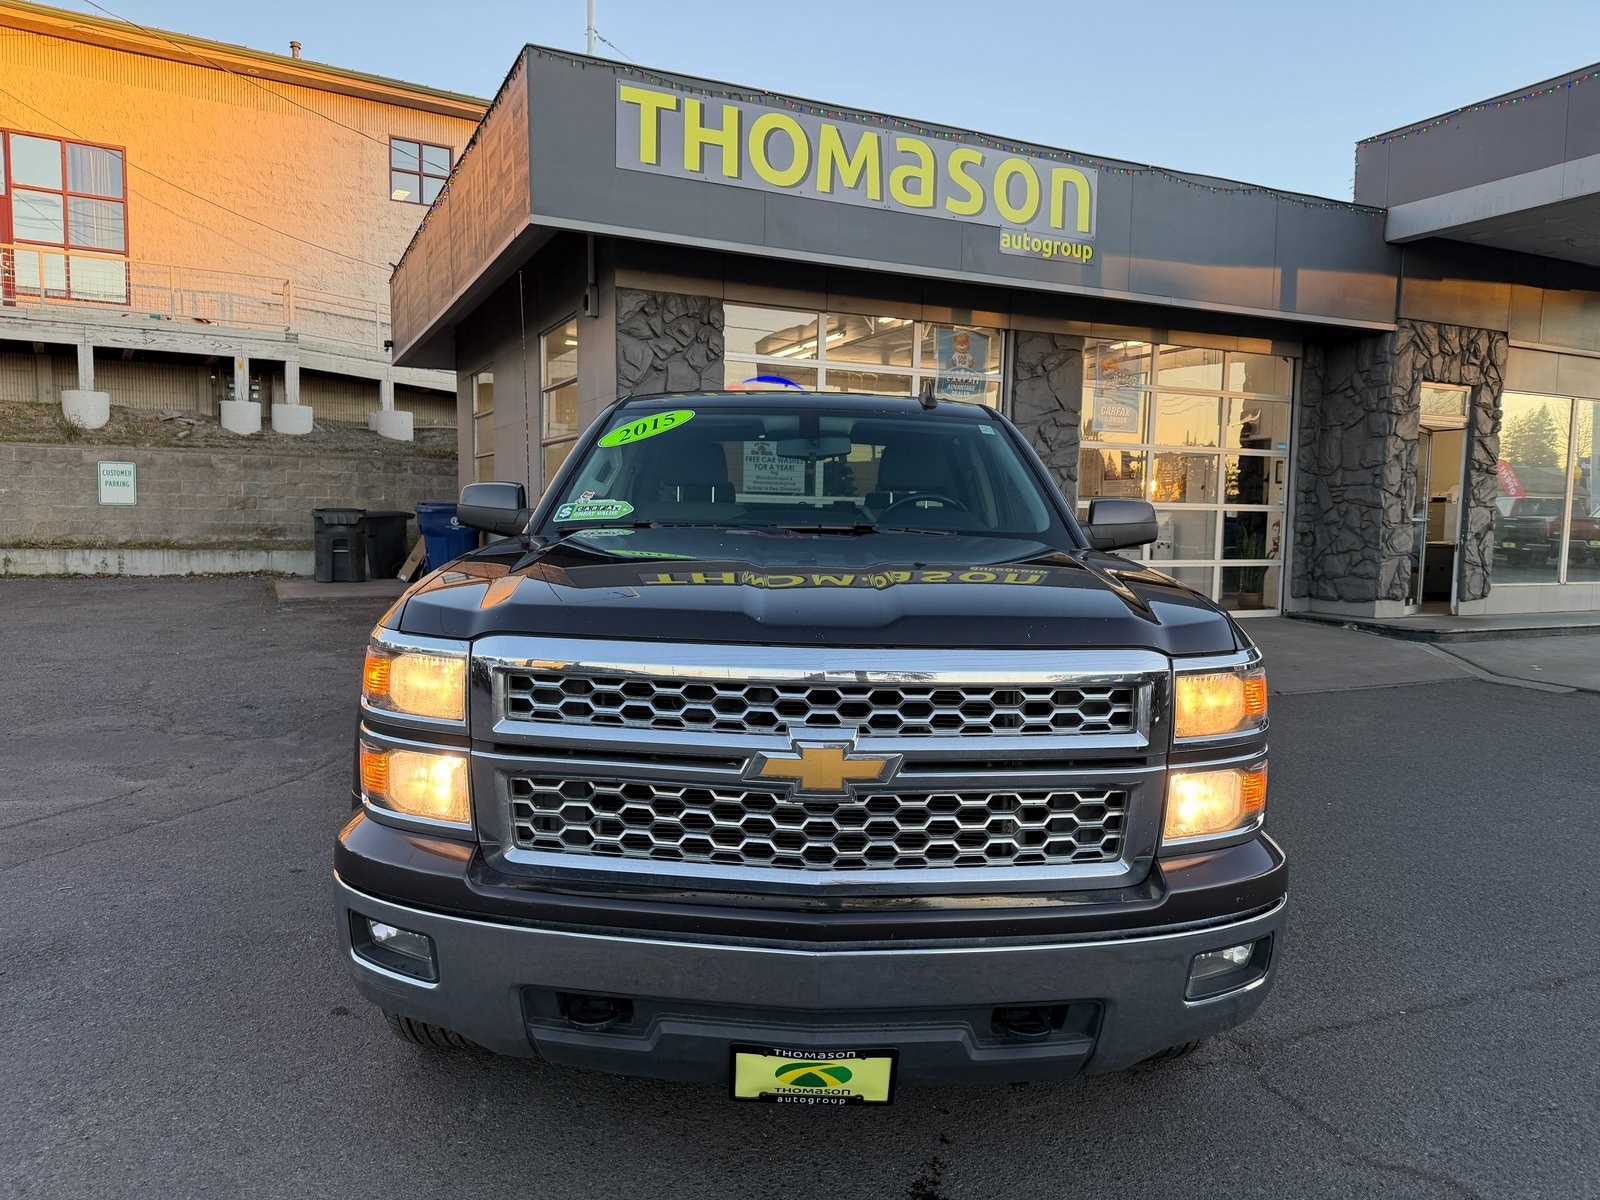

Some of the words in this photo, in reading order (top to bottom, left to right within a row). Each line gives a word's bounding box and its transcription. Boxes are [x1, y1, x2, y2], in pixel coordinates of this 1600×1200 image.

[1001, 232, 1093, 263] autogroup
[1101, 406, 1130, 417] CARFAX
[619, 413, 676, 442] 2015
[102, 469, 132, 477] CUSTOMER
[577, 504, 622, 512] CARFAX
[777, 1096, 846, 1106] autogroup
